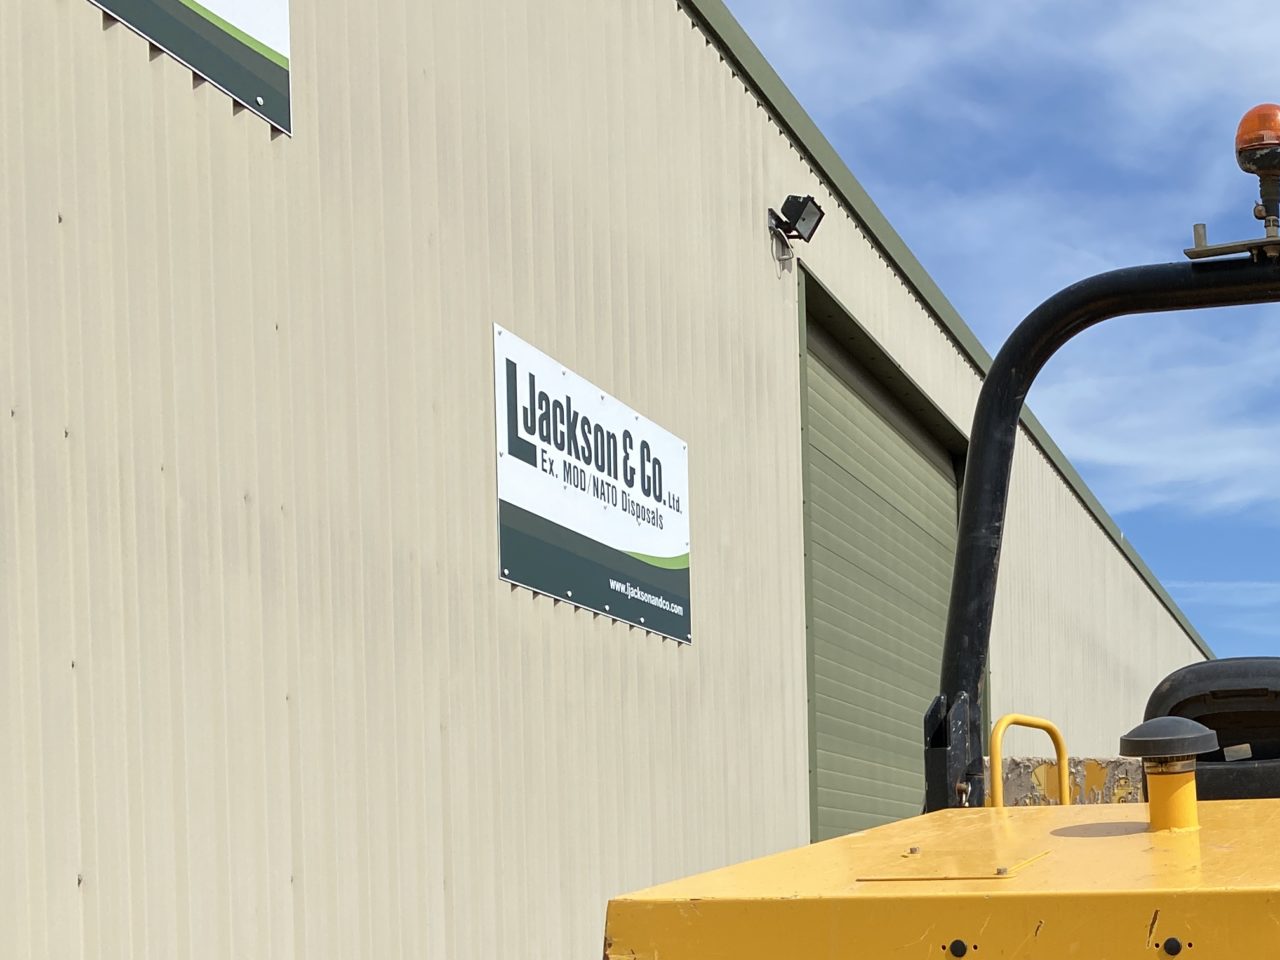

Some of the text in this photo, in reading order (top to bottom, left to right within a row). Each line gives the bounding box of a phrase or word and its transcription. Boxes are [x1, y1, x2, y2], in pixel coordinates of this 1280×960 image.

[622, 429, 636, 489] &
[640, 440, 666, 506] Co.
[667, 490, 683, 514] Ltd.
[621, 489, 664, 530] Disposals
